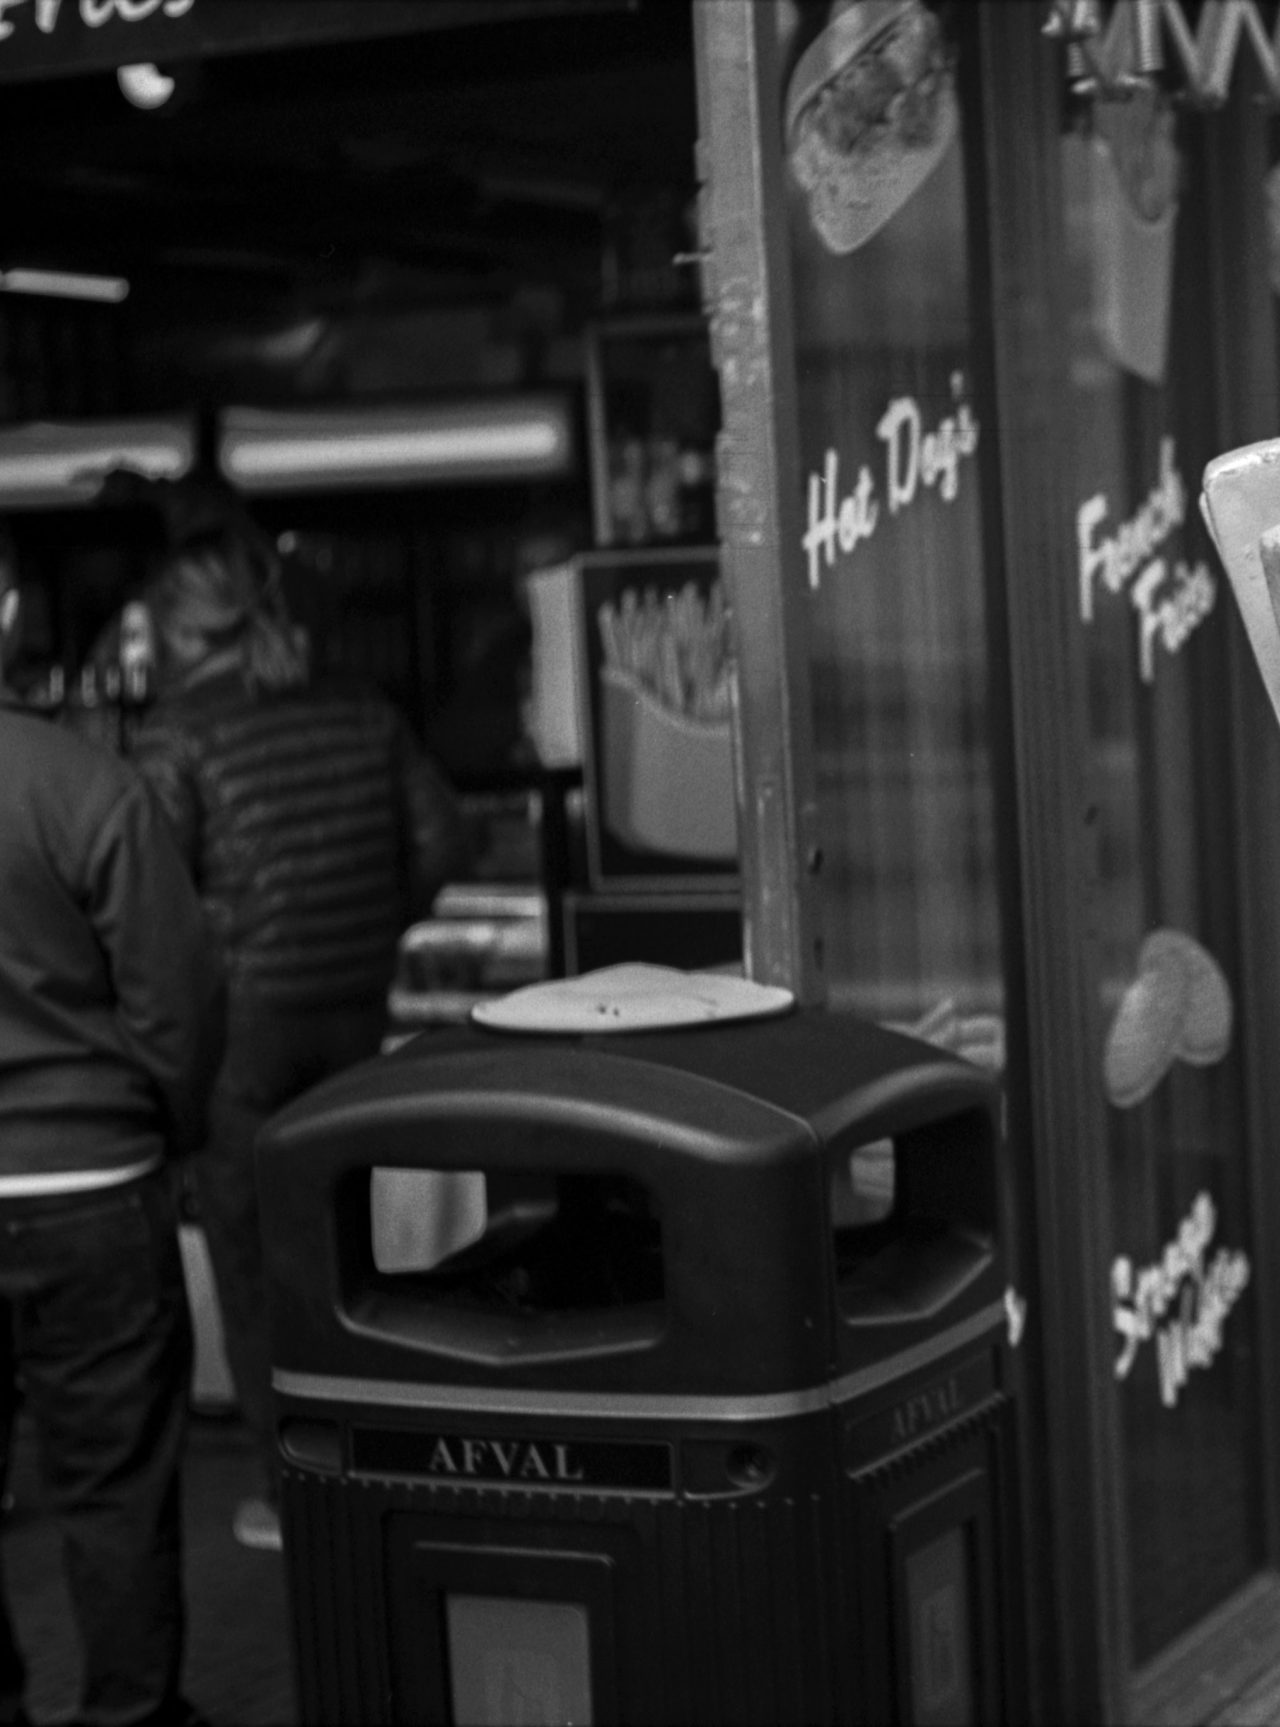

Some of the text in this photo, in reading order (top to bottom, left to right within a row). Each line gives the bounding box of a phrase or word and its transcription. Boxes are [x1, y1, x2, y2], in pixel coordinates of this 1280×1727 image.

[803, 369, 980, 588] Hot Dog's
[1077, 434, 1187, 623] French
[1132, 557, 1217, 684] Fries
[429, 1436, 583, 1480] AFVAL
